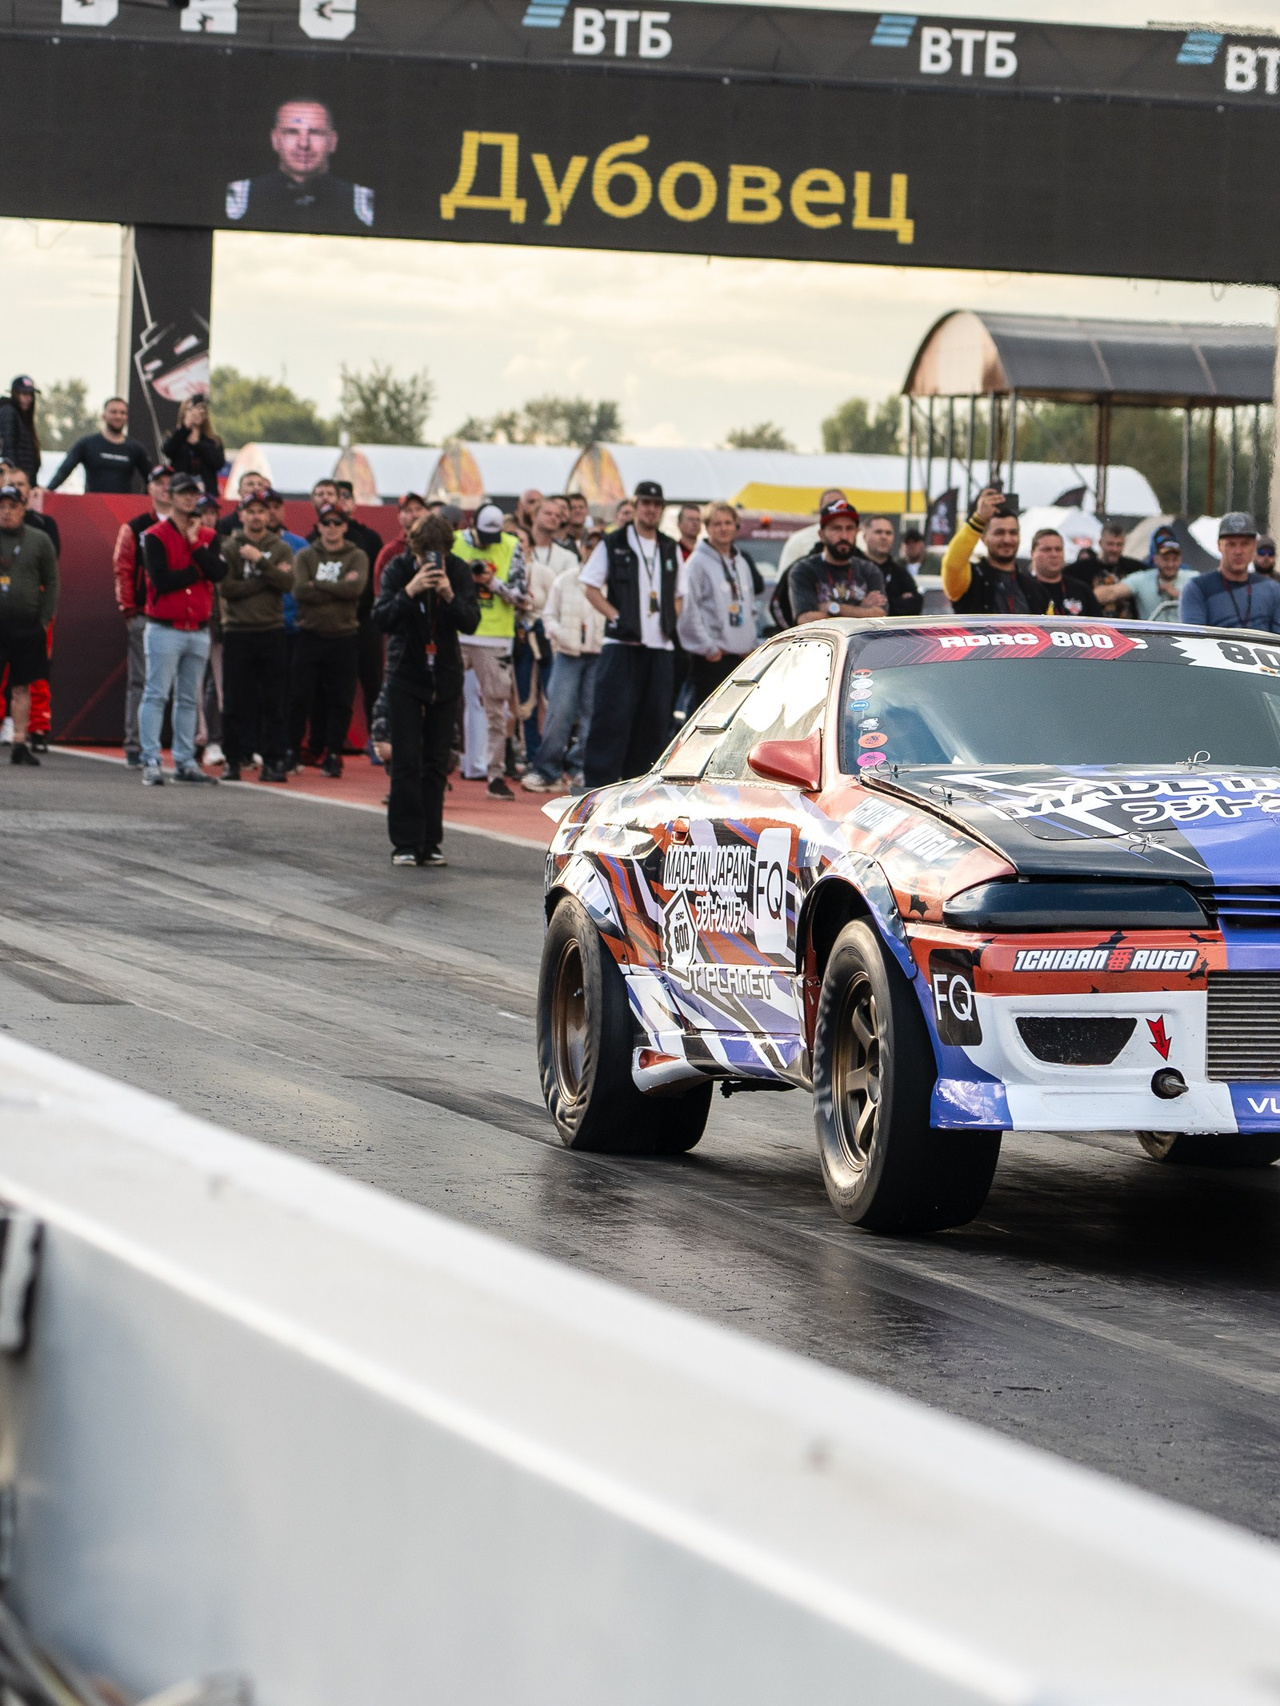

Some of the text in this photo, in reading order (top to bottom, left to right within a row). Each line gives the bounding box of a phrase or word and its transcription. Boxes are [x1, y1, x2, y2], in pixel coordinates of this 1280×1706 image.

[572, 9, 671, 58] ВТБ
[919, 26, 1018, 78] ВТБ
[440, 131, 914, 244] Дубовец
[937, 633, 1040, 649] RDRC
[1050, 631, 1114, 649] 800
[664, 848, 749, 890] MADE IN JAPAN
[756, 860, 784, 921] FQ
[674, 922, 690, 954] 800
[932, 974, 974, 1021] FQ
